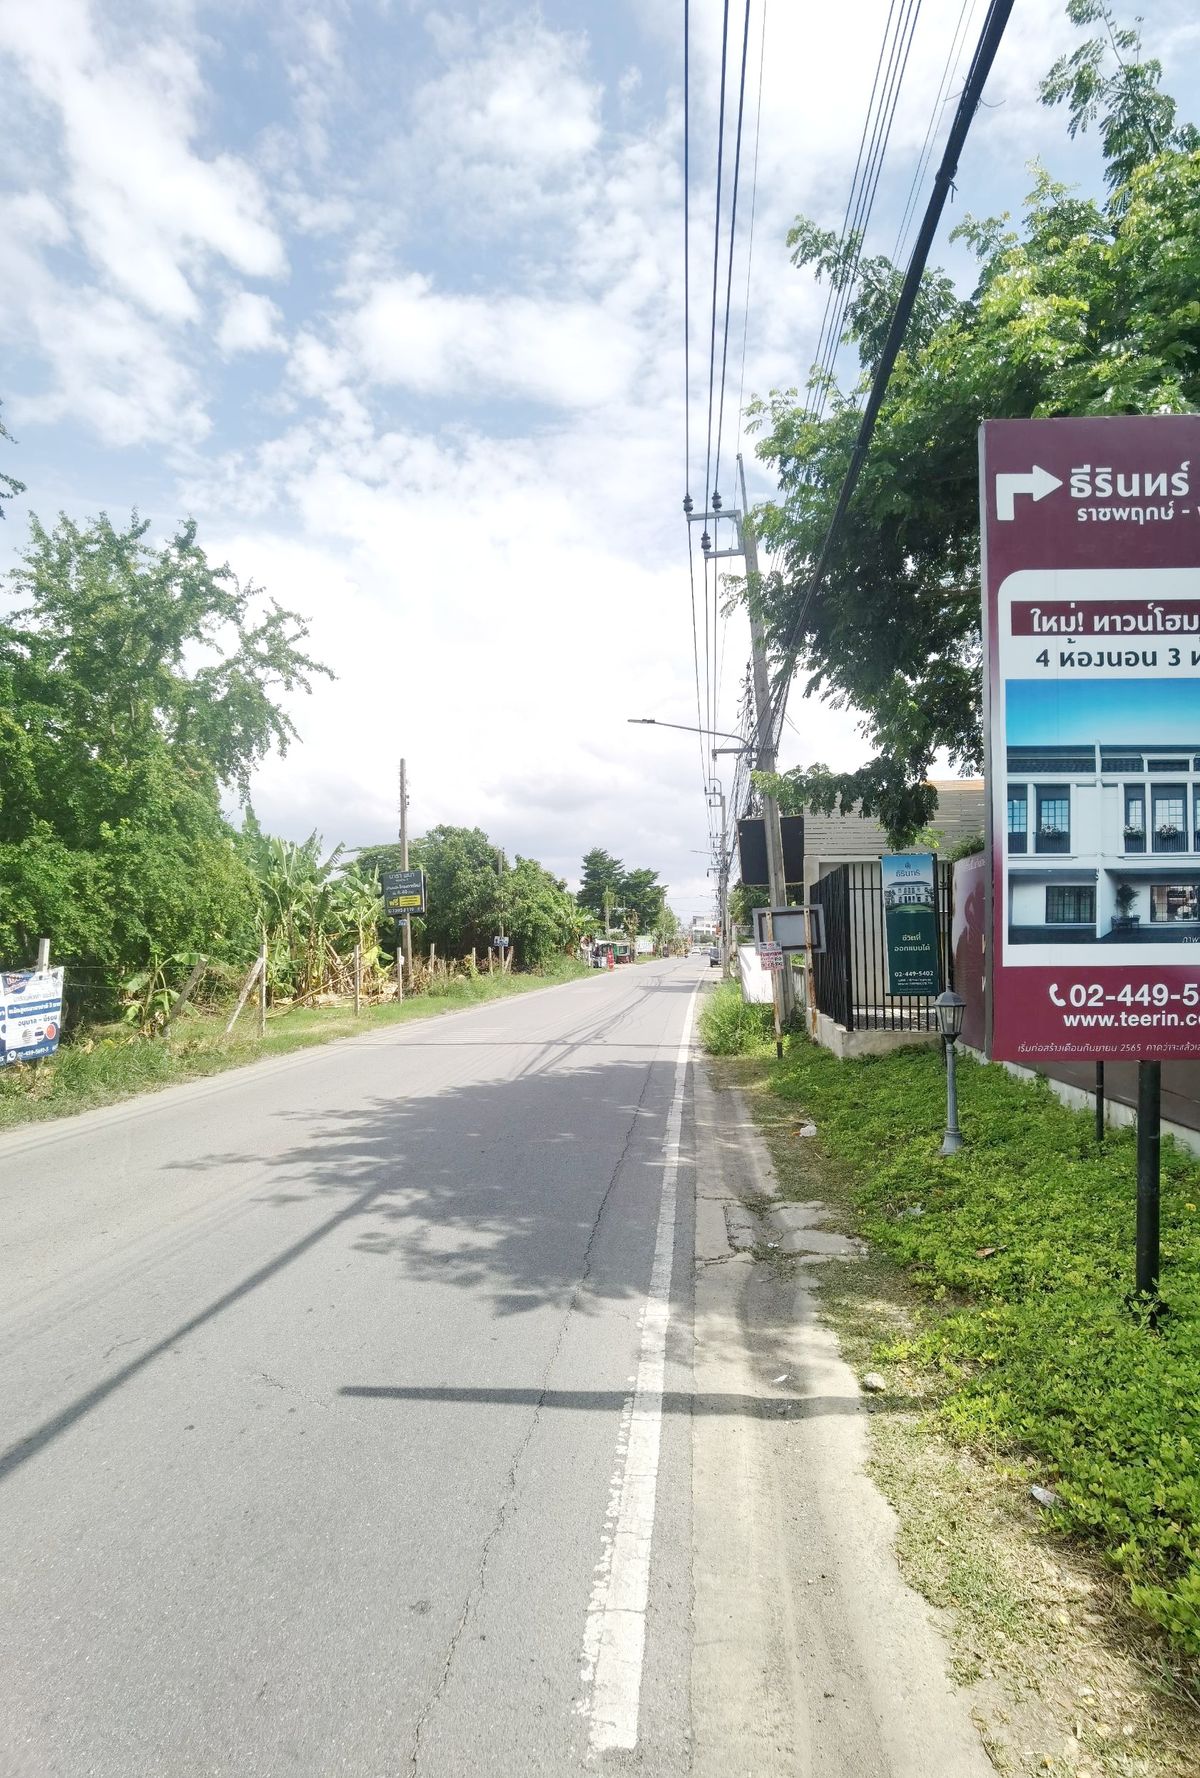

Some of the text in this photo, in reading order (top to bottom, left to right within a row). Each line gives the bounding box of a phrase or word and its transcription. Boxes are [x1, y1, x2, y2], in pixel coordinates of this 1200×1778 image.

[1070, 461, 1190, 498] ธีรินทร์
[1077, 501, 1175, 526] ราชพฤกษ์
[1030, 602, 1200, 632] ใหม่! ทาวน์โฮม
[1035, 650, 1050, 668] 4
[1059, 639, 1158, 667] ห้องนอน
[1168, 648, 1181, 667] 3
[1069, 983, 1199, 1007] 02-449-5
[1063, 1010, 1200, 1027] www.teerin.c
[1120, 1043, 1142, 1052] 2565
